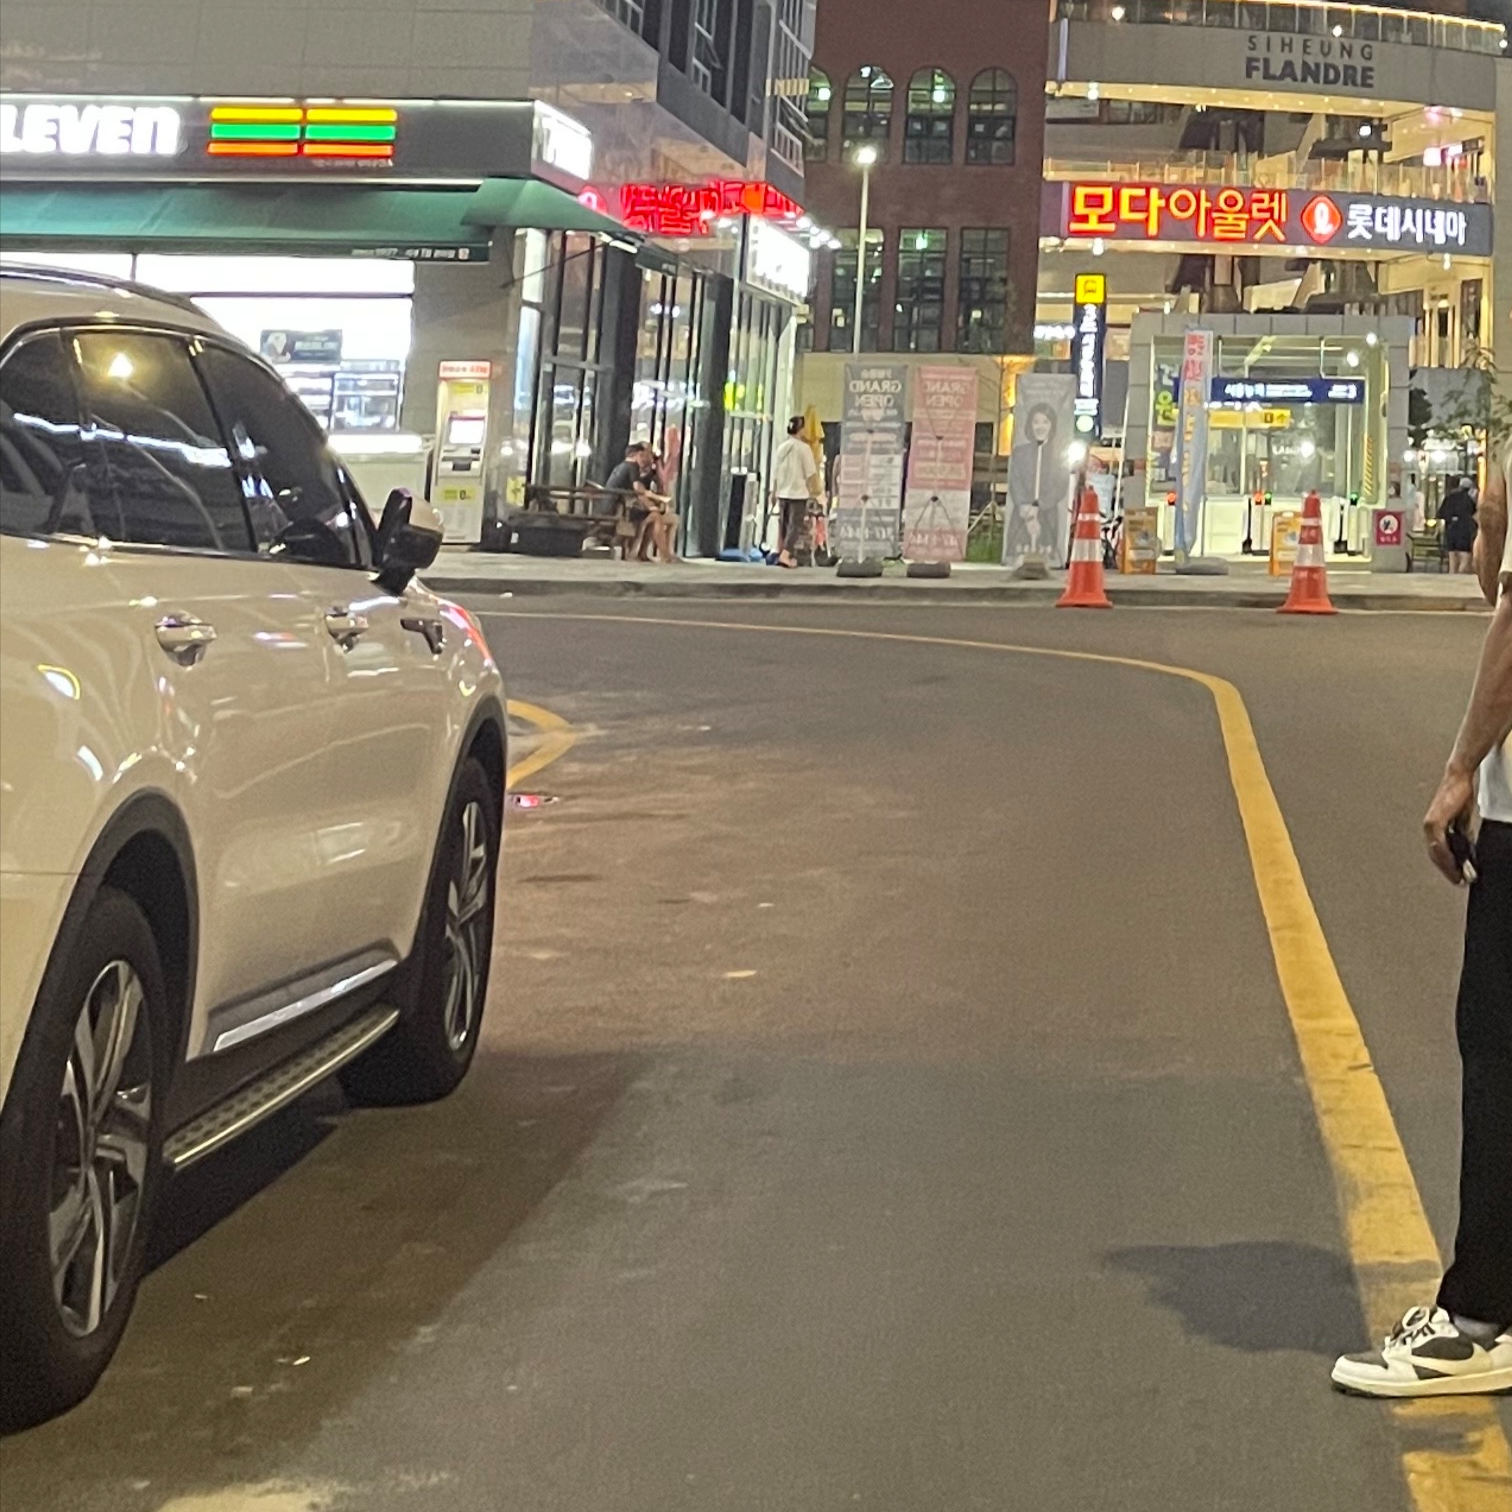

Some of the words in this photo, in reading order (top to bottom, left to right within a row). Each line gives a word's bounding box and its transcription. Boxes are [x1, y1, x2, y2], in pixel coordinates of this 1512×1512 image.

[1247, 34, 1375, 61] SIHEUNG
[1245, 56, 1375, 88] FLANDRE
[1068, 184, 1288, 242] 모다아울렛
[1347, 203, 1467, 246] 롯데시네마
